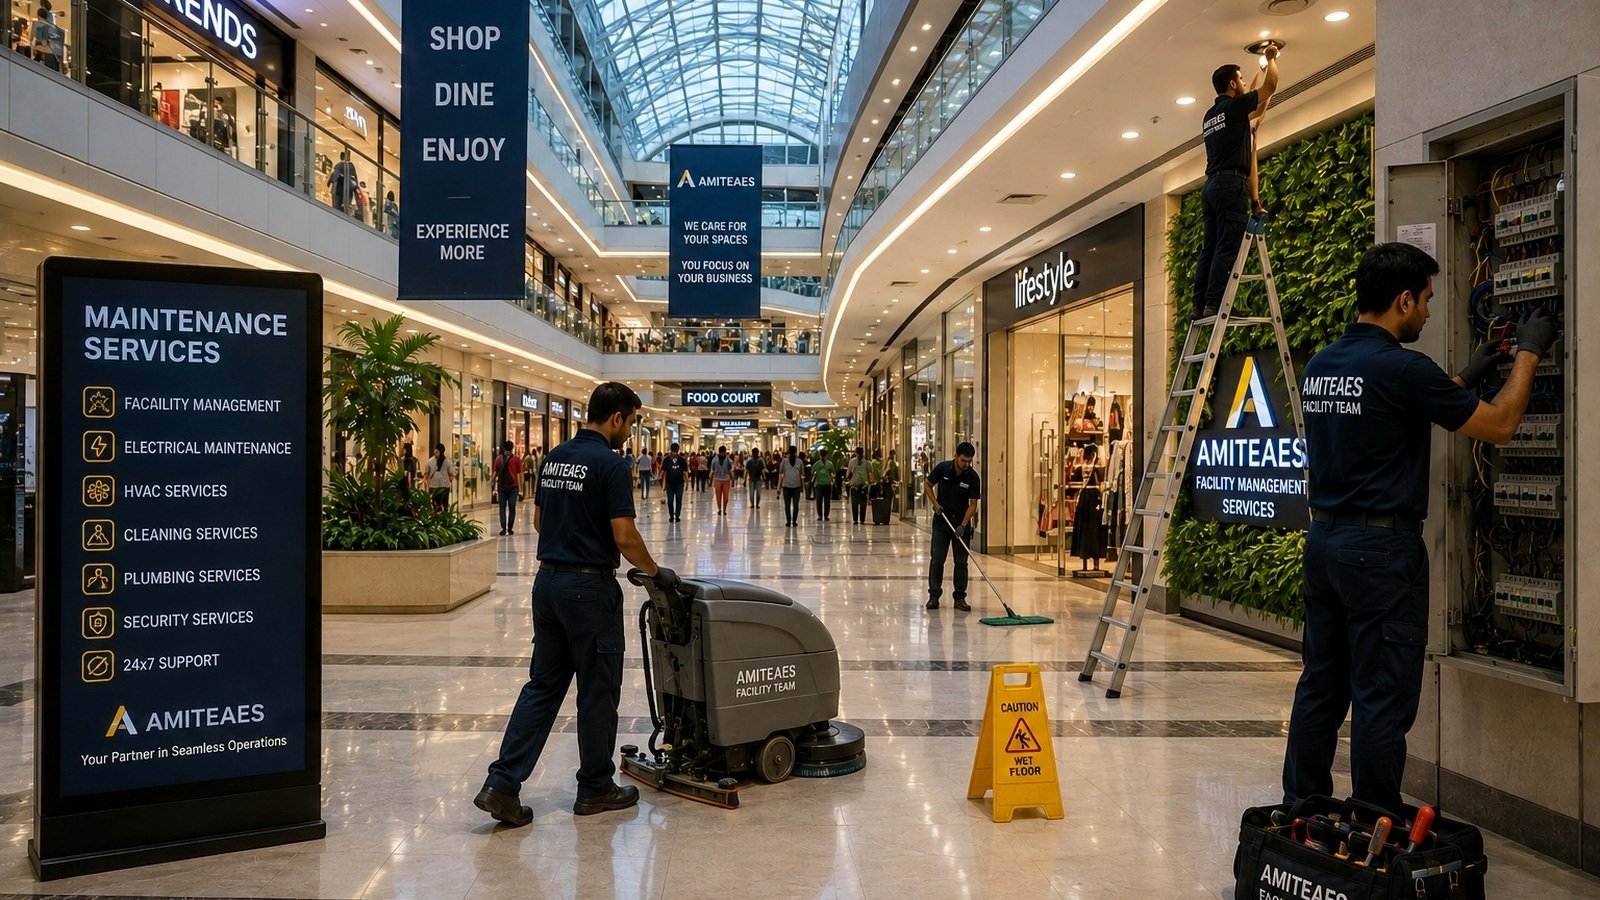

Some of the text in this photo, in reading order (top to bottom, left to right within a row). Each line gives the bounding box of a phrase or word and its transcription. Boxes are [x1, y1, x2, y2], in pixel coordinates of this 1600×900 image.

[163, 0, 258, 59] ENDS
[430, 25, 500, 50] SHOP
[435, 82, 494, 106] DINE
[422, 137, 505, 161] ENJOY
[698, 176, 755, 186] AMITEAES
[416, 223, 509, 239] EXPERIENCE
[684, 221, 747, 231] WE CARE FOR
[683, 235, 748, 244] YOUR SPACES
[440, 245, 485, 260] MORE
[681, 261, 750, 270] YOU FOCUS ON
[678, 273, 753, 283] YOUR BUSINESS
[1015, 251, 1074, 309] lifestyle
[84, 305, 288, 336] MAINTENANCE
[84, 336, 220, 364] SERVICES
[1302, 376, 1364, 397] AMITEAES
[124, 397, 281, 412] FACAILITY MANAGEMENT
[687, 392, 760, 403] FOOD COURT
[1302, 400, 1361, 415] FACILITY TEAM
[124, 440, 292, 455] ELECTRICAL MAINTENANCE
[1196, 437, 1308, 468] AMITEAES
[541, 461, 588, 479] AMITEAES
[124, 484, 228, 498] HVAC SERVICES
[566, 480, 583, 492] TEAM
[1196, 475, 1307, 495] FACILITY MANAGEMENT
[1222, 498, 1275, 518] SERVICES
[124, 526, 258, 542] CLEANING SERVICES
[124, 568, 261, 585] PLUMBING SERVICES
[123, 610, 254, 629] SECURITY SERVICES
[123, 653, 220, 672] 24x7 SUPPORT
[736, 664, 796, 685] AMITEAES
[736, 681, 796, 698] FACILITY TEAM
[1000, 702, 1039, 713] CAUTION
[145, 703, 265, 732] AMITEAES
[81, 735, 288, 766] Your Partner in Seamless Operations
[1014, 756, 1033, 766] WET
[1009, 766, 1041, 776] FLOOR
